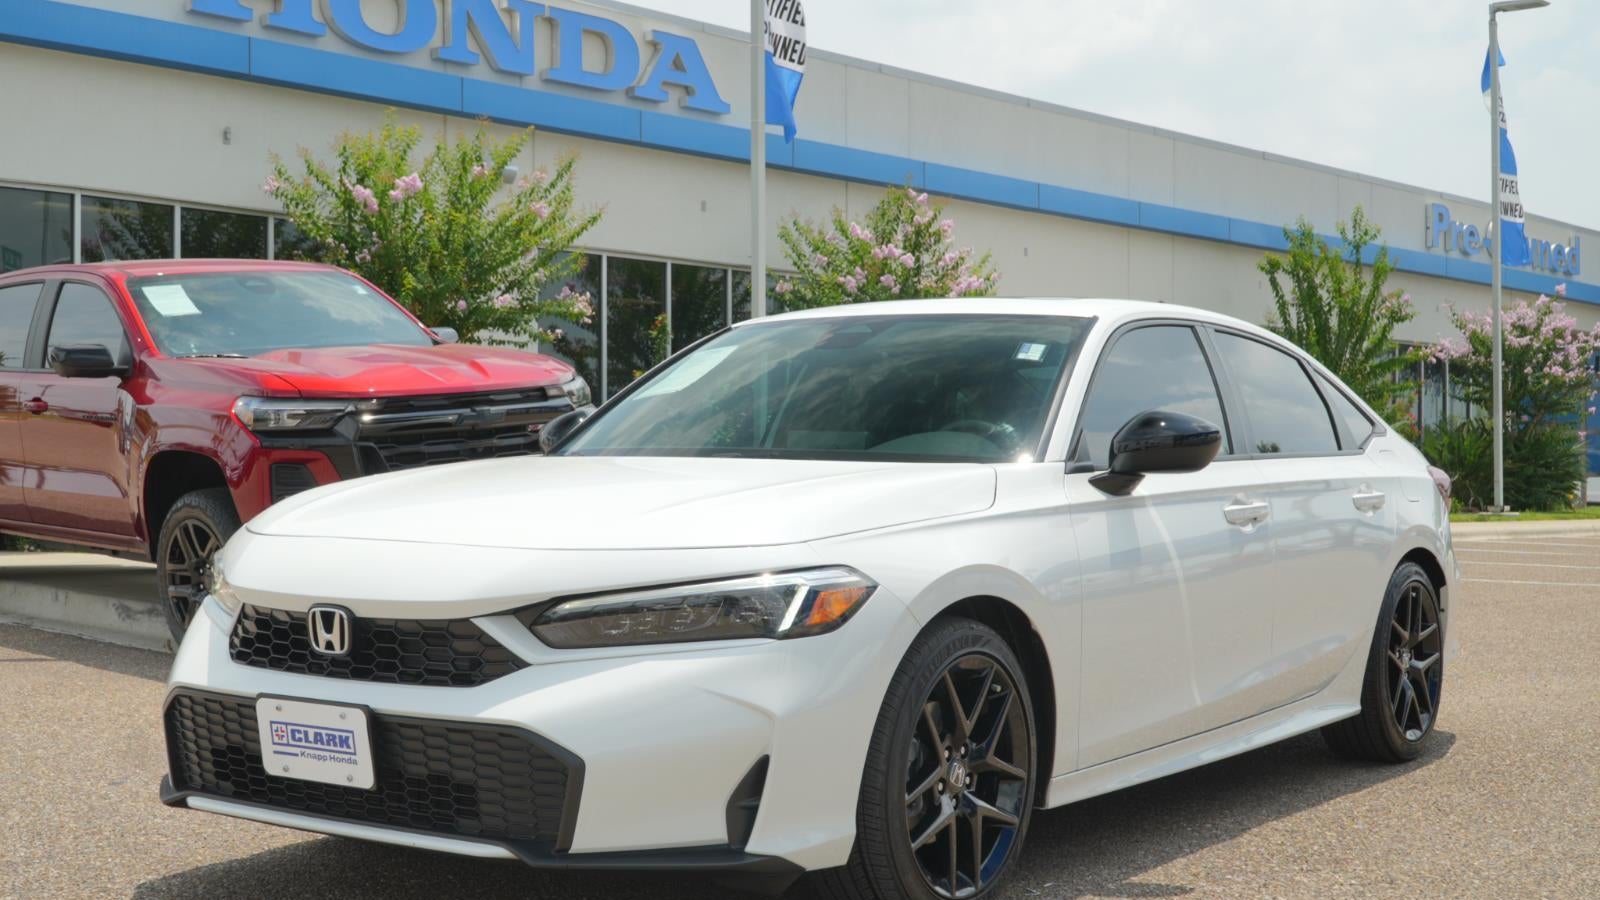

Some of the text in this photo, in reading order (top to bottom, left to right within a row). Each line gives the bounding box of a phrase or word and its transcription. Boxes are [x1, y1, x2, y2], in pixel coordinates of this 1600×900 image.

[290, 728, 352, 749] CLARK
[300, 750, 358, 766] Knapp Honda
